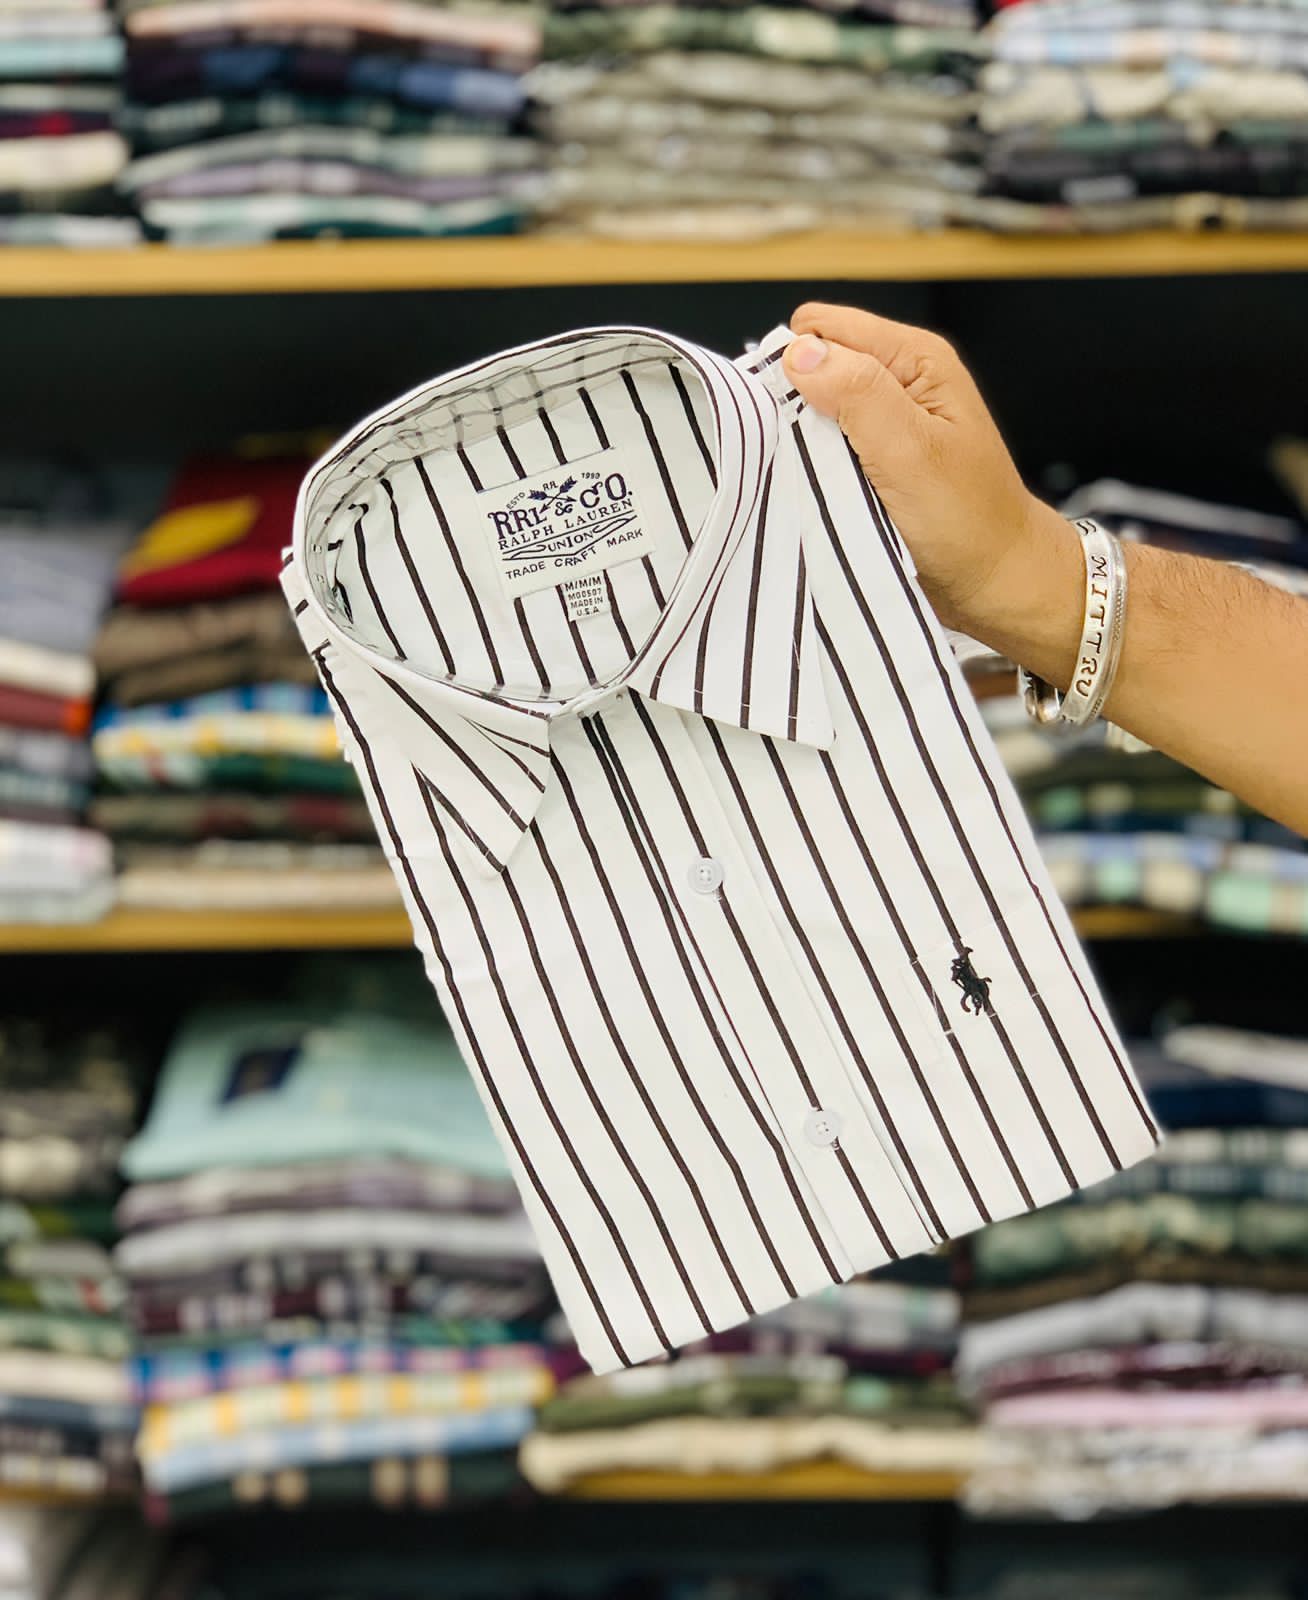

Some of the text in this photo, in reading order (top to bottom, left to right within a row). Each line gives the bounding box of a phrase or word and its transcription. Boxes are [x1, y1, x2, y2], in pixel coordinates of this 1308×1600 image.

[487, 507, 548, 540] RRL
[554, 501, 574, 517] &
[498, 498, 633, 551] RALPH LAUREN
[506, 528, 644, 580] TRADE CRAFT MARK
[547, 531, 594, 552] UNION
[564, 576, 602, 592] M/M/M
